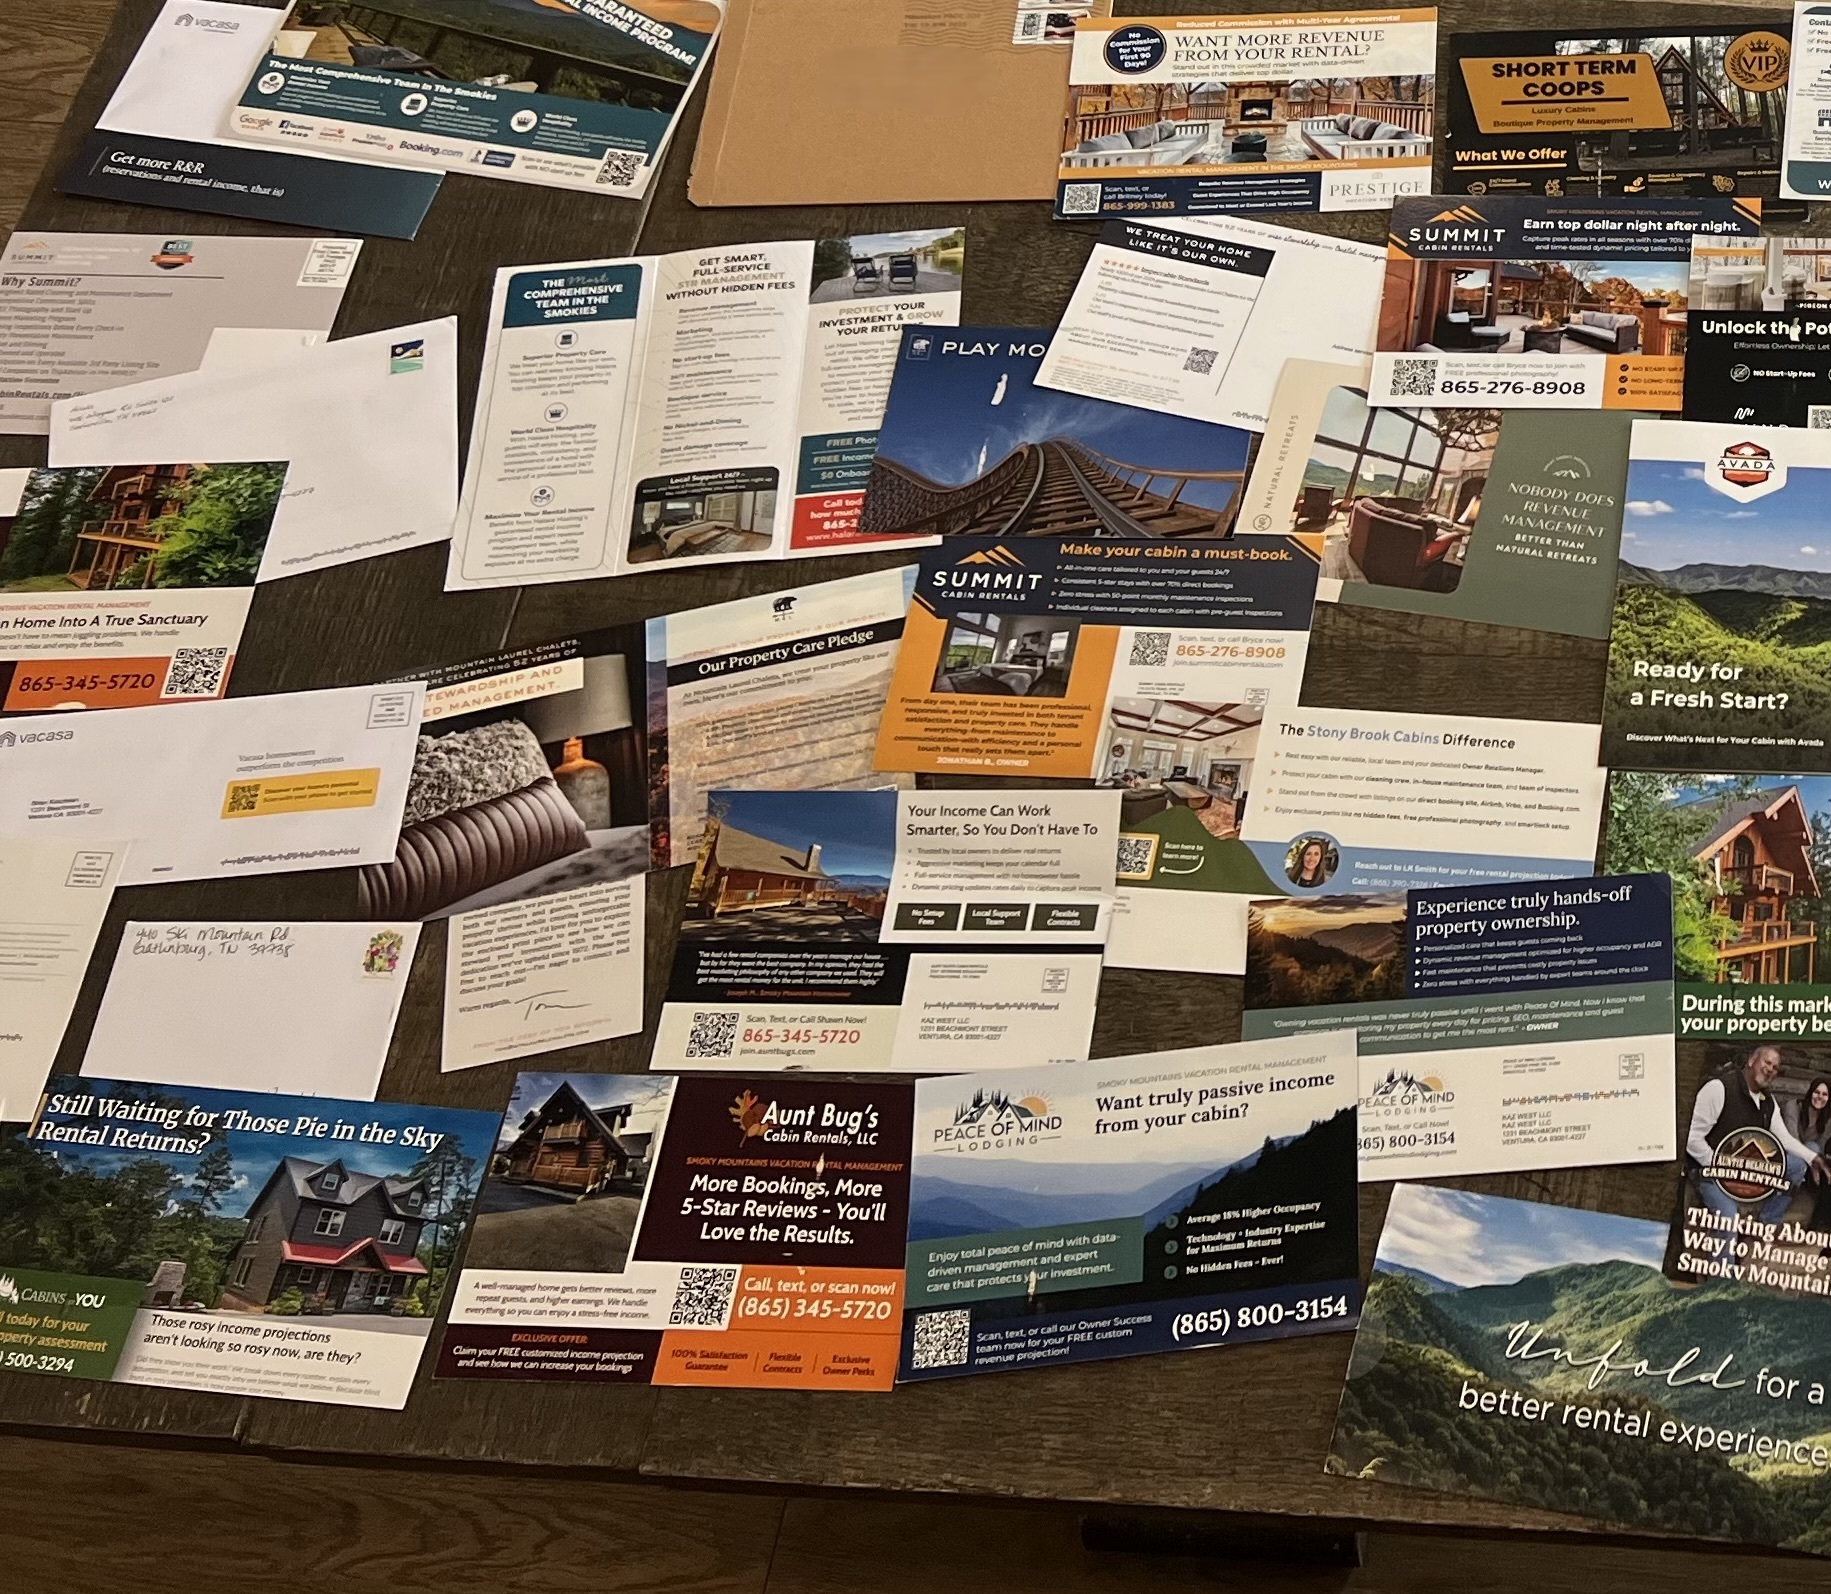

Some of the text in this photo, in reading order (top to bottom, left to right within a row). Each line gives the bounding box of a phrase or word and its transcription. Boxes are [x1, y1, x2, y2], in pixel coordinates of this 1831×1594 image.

[195, 18, 240, 30] vacasa
[1175, 30, 1385, 48] WANT MORE REVENUE
[1491, 59, 1636, 78] SHORT TERM
[1742, 55, 1776, 73] VIP
[1522, 81, 1605, 97] COOPS
[1531, 106, 1596, 115] Luxury Cabins
[1492, 116, 1634, 129] Boutique Property Management
[400, 141, 464, 158] Booking.com
[1455, 148, 1567, 162] What We Offer
[110, 151, 204, 174] Get more R&R
[1329, 181, 1424, 196] PRESTIGE
[1103, 201, 1175, 212] 865-999-1383
[1408, 228, 1506, 242] SUMMIT
[1418, 244, 1494, 252] CABIN RENTALS
[1, 276, 81, 288] Why Summit?
[665, 281, 796, 302] WITHOUT HIDDEN FEES
[1440, 380, 1585, 396] 865-276-8908
[1717, 458, 1776, 471] AVADA
[932, 572, 1043, 590] SUMMIT
[1633, 661, 1743, 684] Ready for
[19, 673, 155, 692] 865-345-5720
[1279, 723, 1516, 749] The Stony Brook Cabins Difference
[1417, 885, 1633, 919] Experience truly hands-off
[742, 1028, 860, 1044] 865-345-5720
[37, 1121, 211, 1156] Rental Returns?
[763, 1130, 878, 1145] Cabin Rentals, LLC
[928, 1232, 1121, 1264] Enjoy total peace of mind with data-
[744, 1277, 895, 1296] Call, text, or scan now!
[737, 1298, 892, 1321] (865) 345-5720
[1172, 1295, 1348, 1342] (865) 800-3154
[1458, 1381, 1555, 1422] better
[1561, 1399, 1654, 1440] rental
